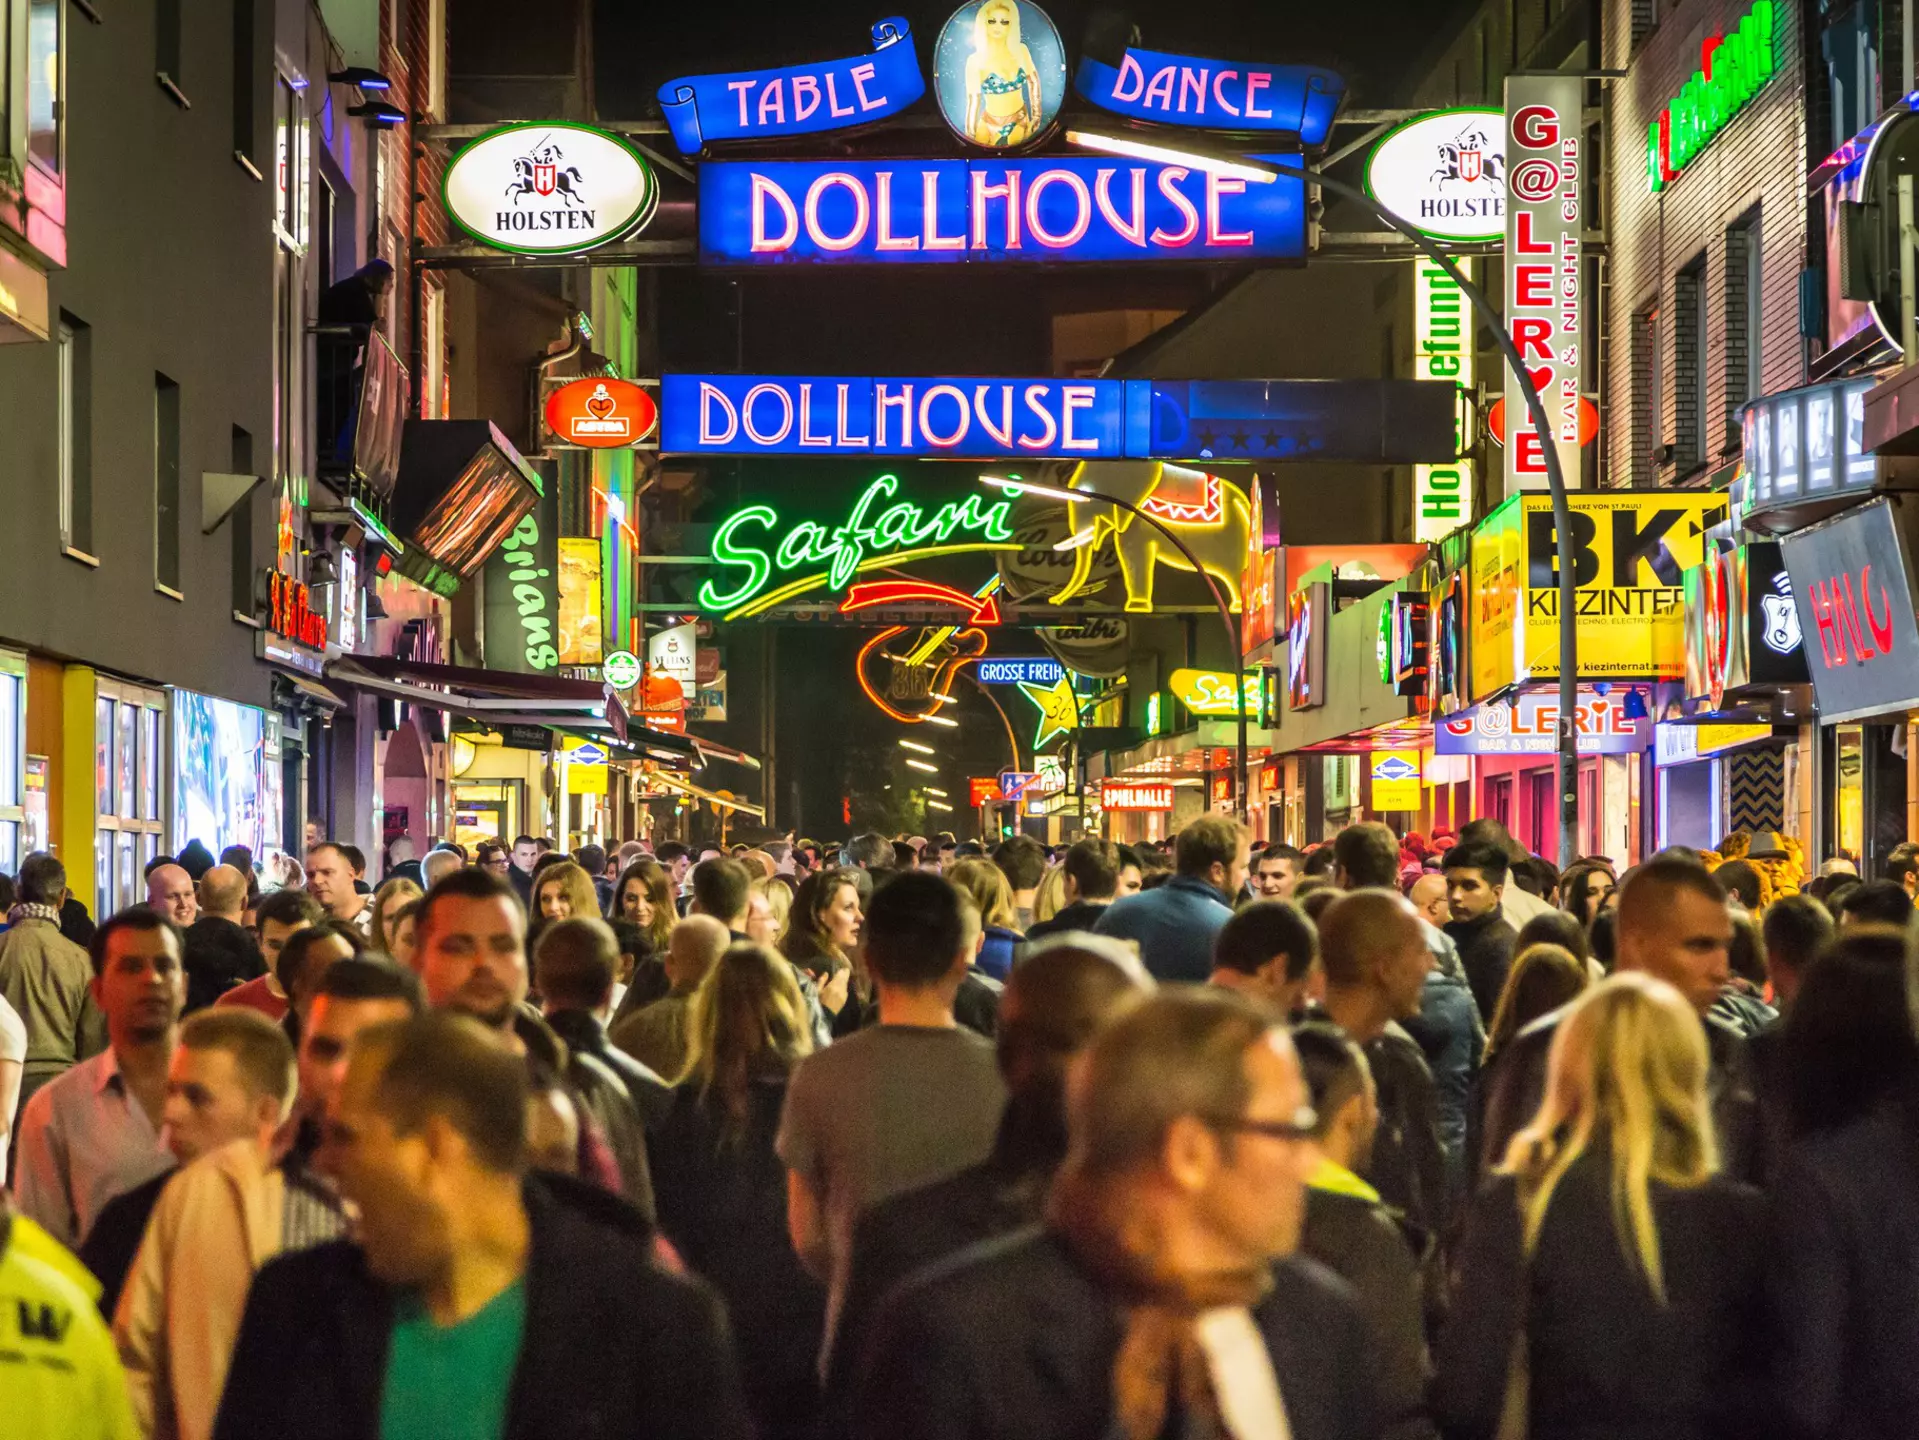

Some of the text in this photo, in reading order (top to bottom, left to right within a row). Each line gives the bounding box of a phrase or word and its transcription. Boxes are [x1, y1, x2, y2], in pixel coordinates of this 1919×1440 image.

[728, 63, 888, 127] TABLE
[1111, 54, 1272, 118] DANCE
[496, 209, 596, 231] HOLSTEN
[750, 165, 1254, 253] DOLLHOUSE
[1421, 197, 1505, 218] HOLSTE
[1561, 137, 1578, 443] BAR & NIGHT CLUB
[699, 381, 1099, 449] DOLLHOUSE
[699, 473, 1023, 611] Safari
[501, 514, 558, 670] Brians
[1529, 588, 1684, 616] KIZINTE
[1577, 618, 1608, 627] ECHNO,
[980, 662, 1063, 681] GROSSE FREIH
[1478, 739, 1507, 751] BAR
[1526, 739, 1556, 751] NIGH
[1578, 738, 1601, 750] LUB
[1103, 788, 1172, 808] SPIELHALLE
